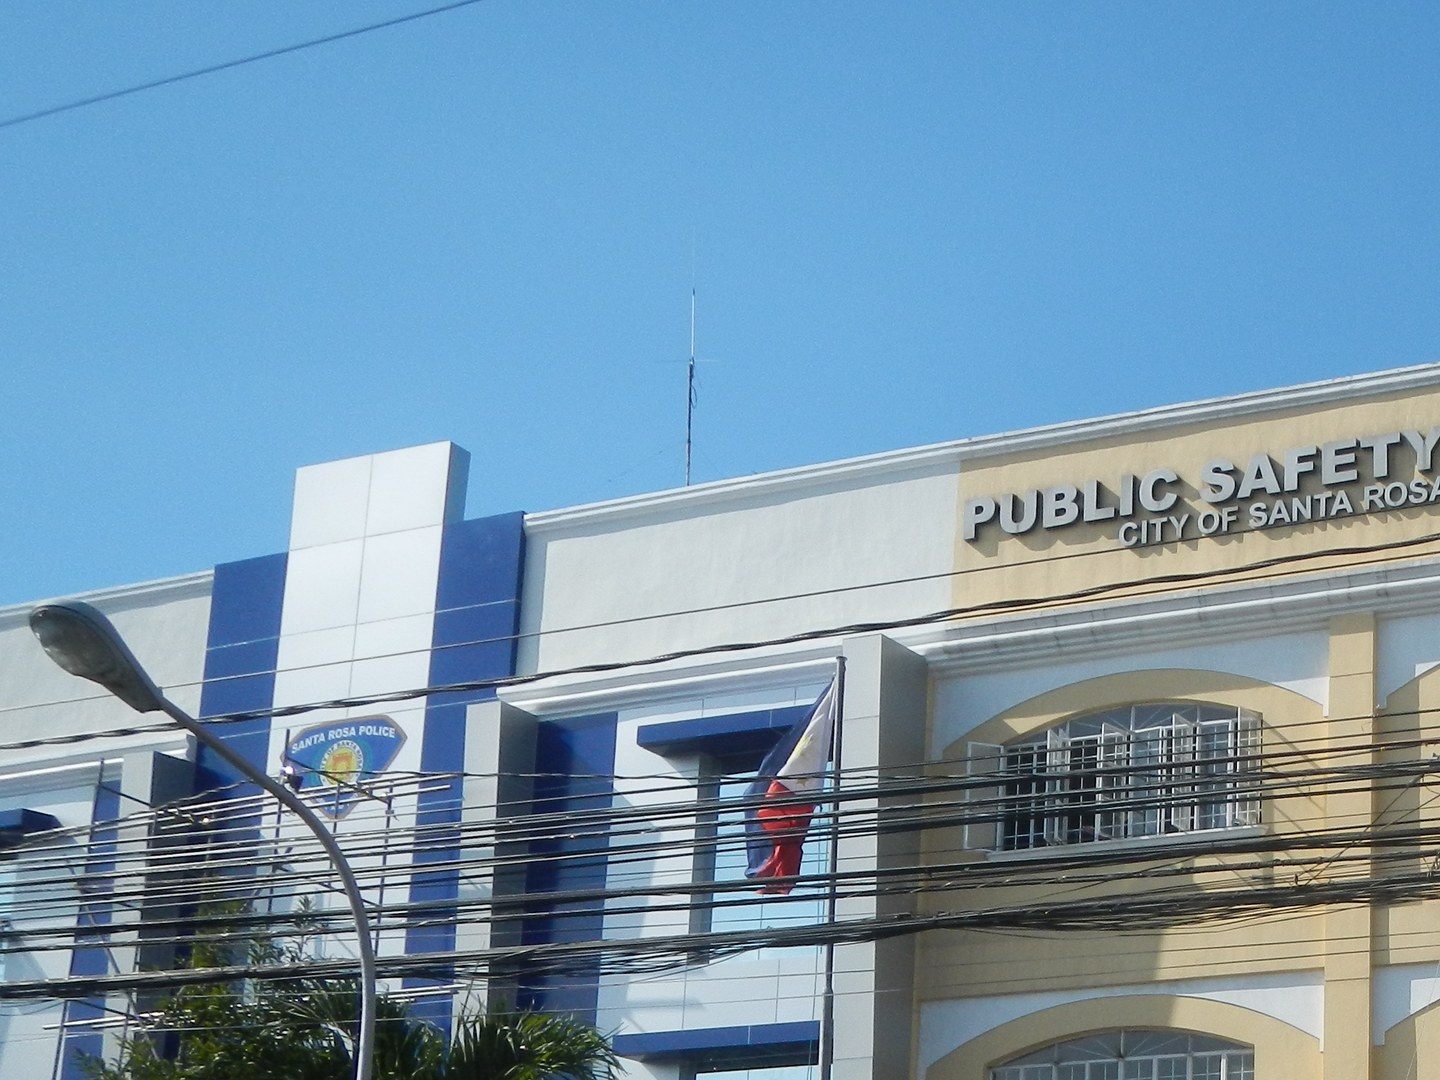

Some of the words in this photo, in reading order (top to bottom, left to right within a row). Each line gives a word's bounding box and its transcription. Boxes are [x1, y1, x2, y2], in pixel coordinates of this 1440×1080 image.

[963, 469, 1179, 541] PUBLIC
[1118, 513, 1189, 547] CITY
[1197, 506, 1239, 535] OF
[1248, 490, 1353, 528] SANTA
[291, 733, 326, 754] SANTA
[328, 728, 356, 741] ROSA
[359, 725, 395, 738] POLICE
